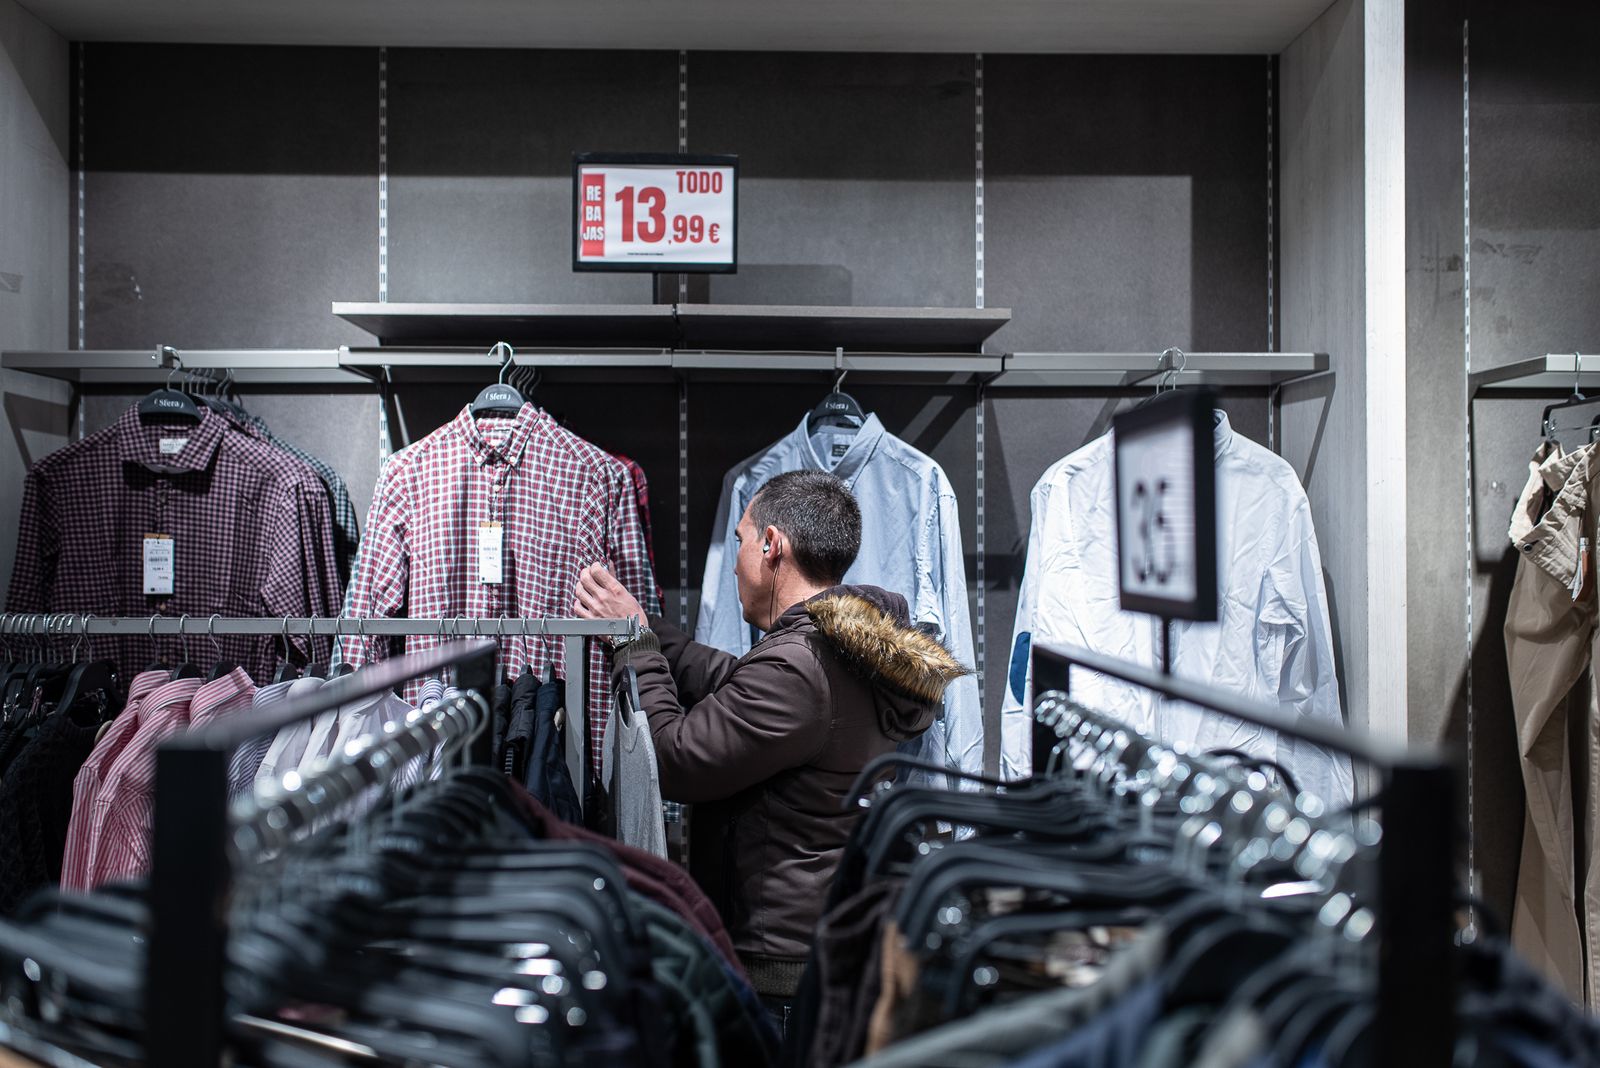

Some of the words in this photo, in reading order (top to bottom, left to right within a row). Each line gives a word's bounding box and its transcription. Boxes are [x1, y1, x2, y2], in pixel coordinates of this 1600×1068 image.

[676, 171, 723, 194] TODO
[586, 185, 601, 201] RE
[585, 206, 602, 222] BA
[583, 227, 604, 241] JAS
